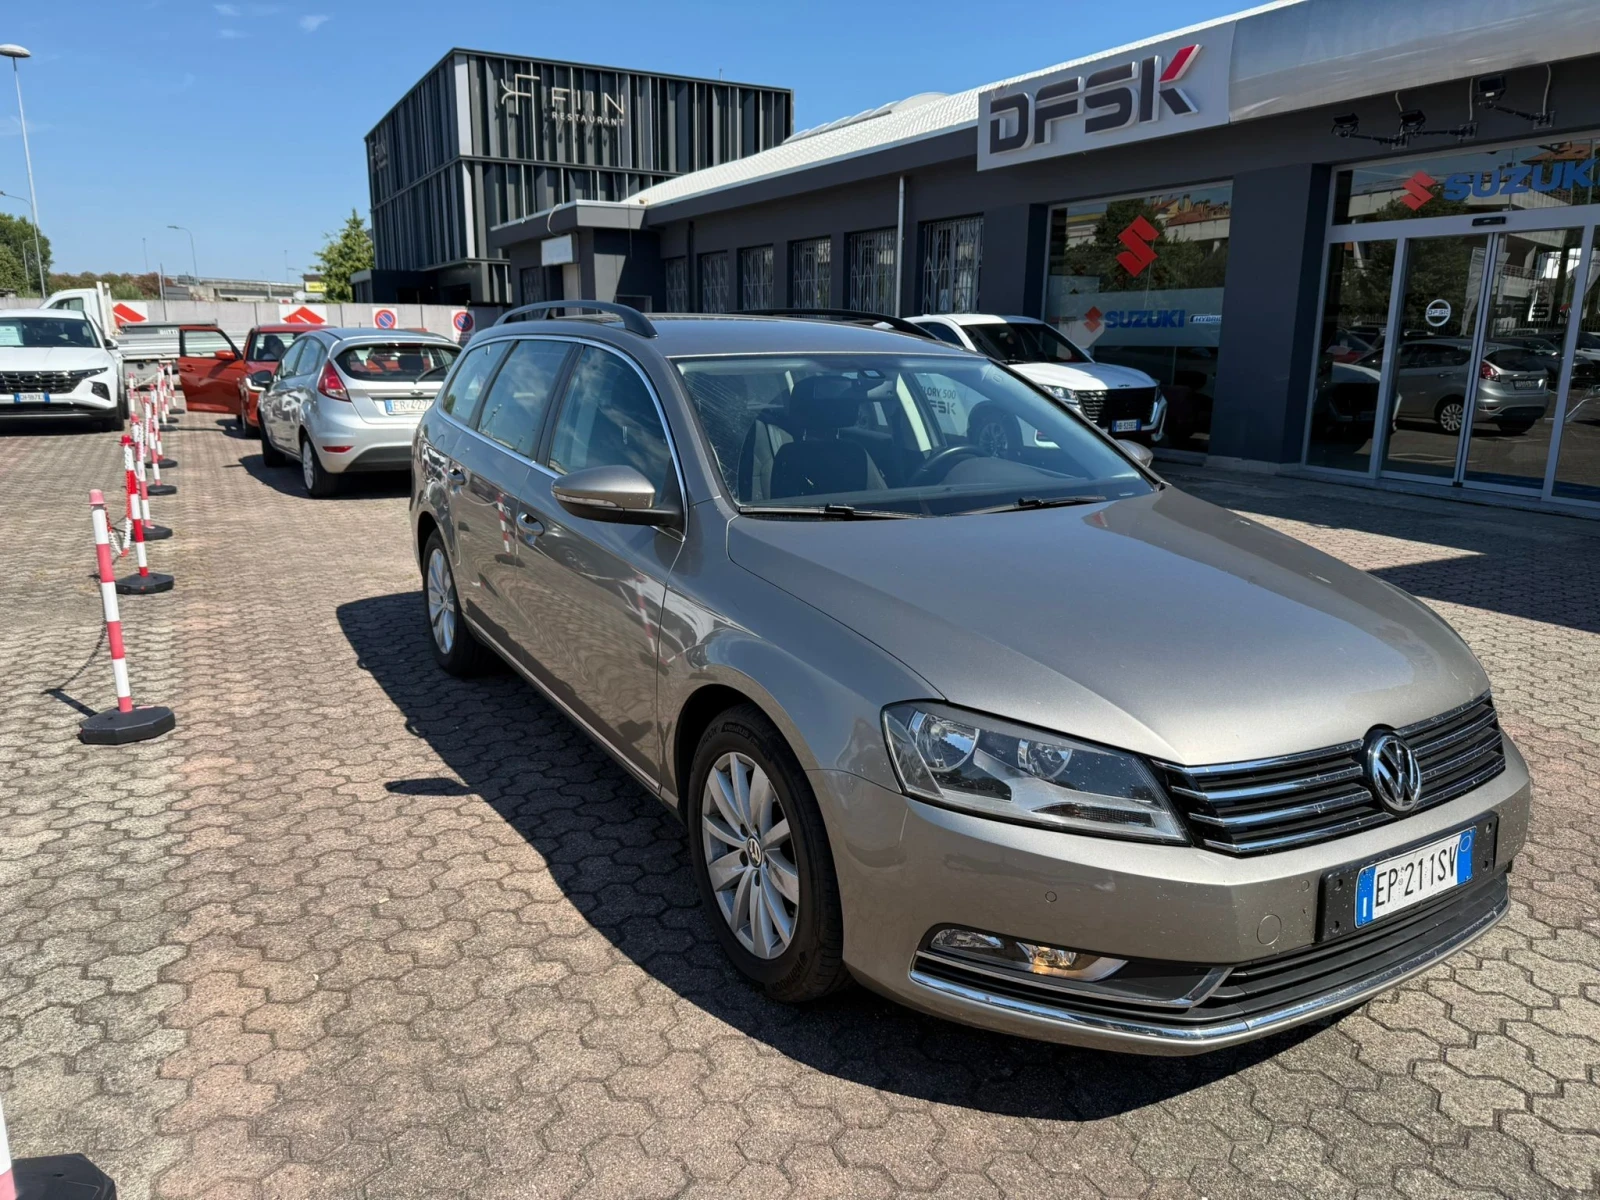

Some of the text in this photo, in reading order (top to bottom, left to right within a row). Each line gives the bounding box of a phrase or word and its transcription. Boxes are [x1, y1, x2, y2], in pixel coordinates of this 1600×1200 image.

[989, 45, 1200, 154] DFSK
[551, 111, 625, 126] RESTAURANT
[1443, 157, 1600, 200] SUZUK
[1104, 309, 1186, 328] SUZUKI
[943, 388, 957, 399] 500
[929, 400, 957, 415] FSK
